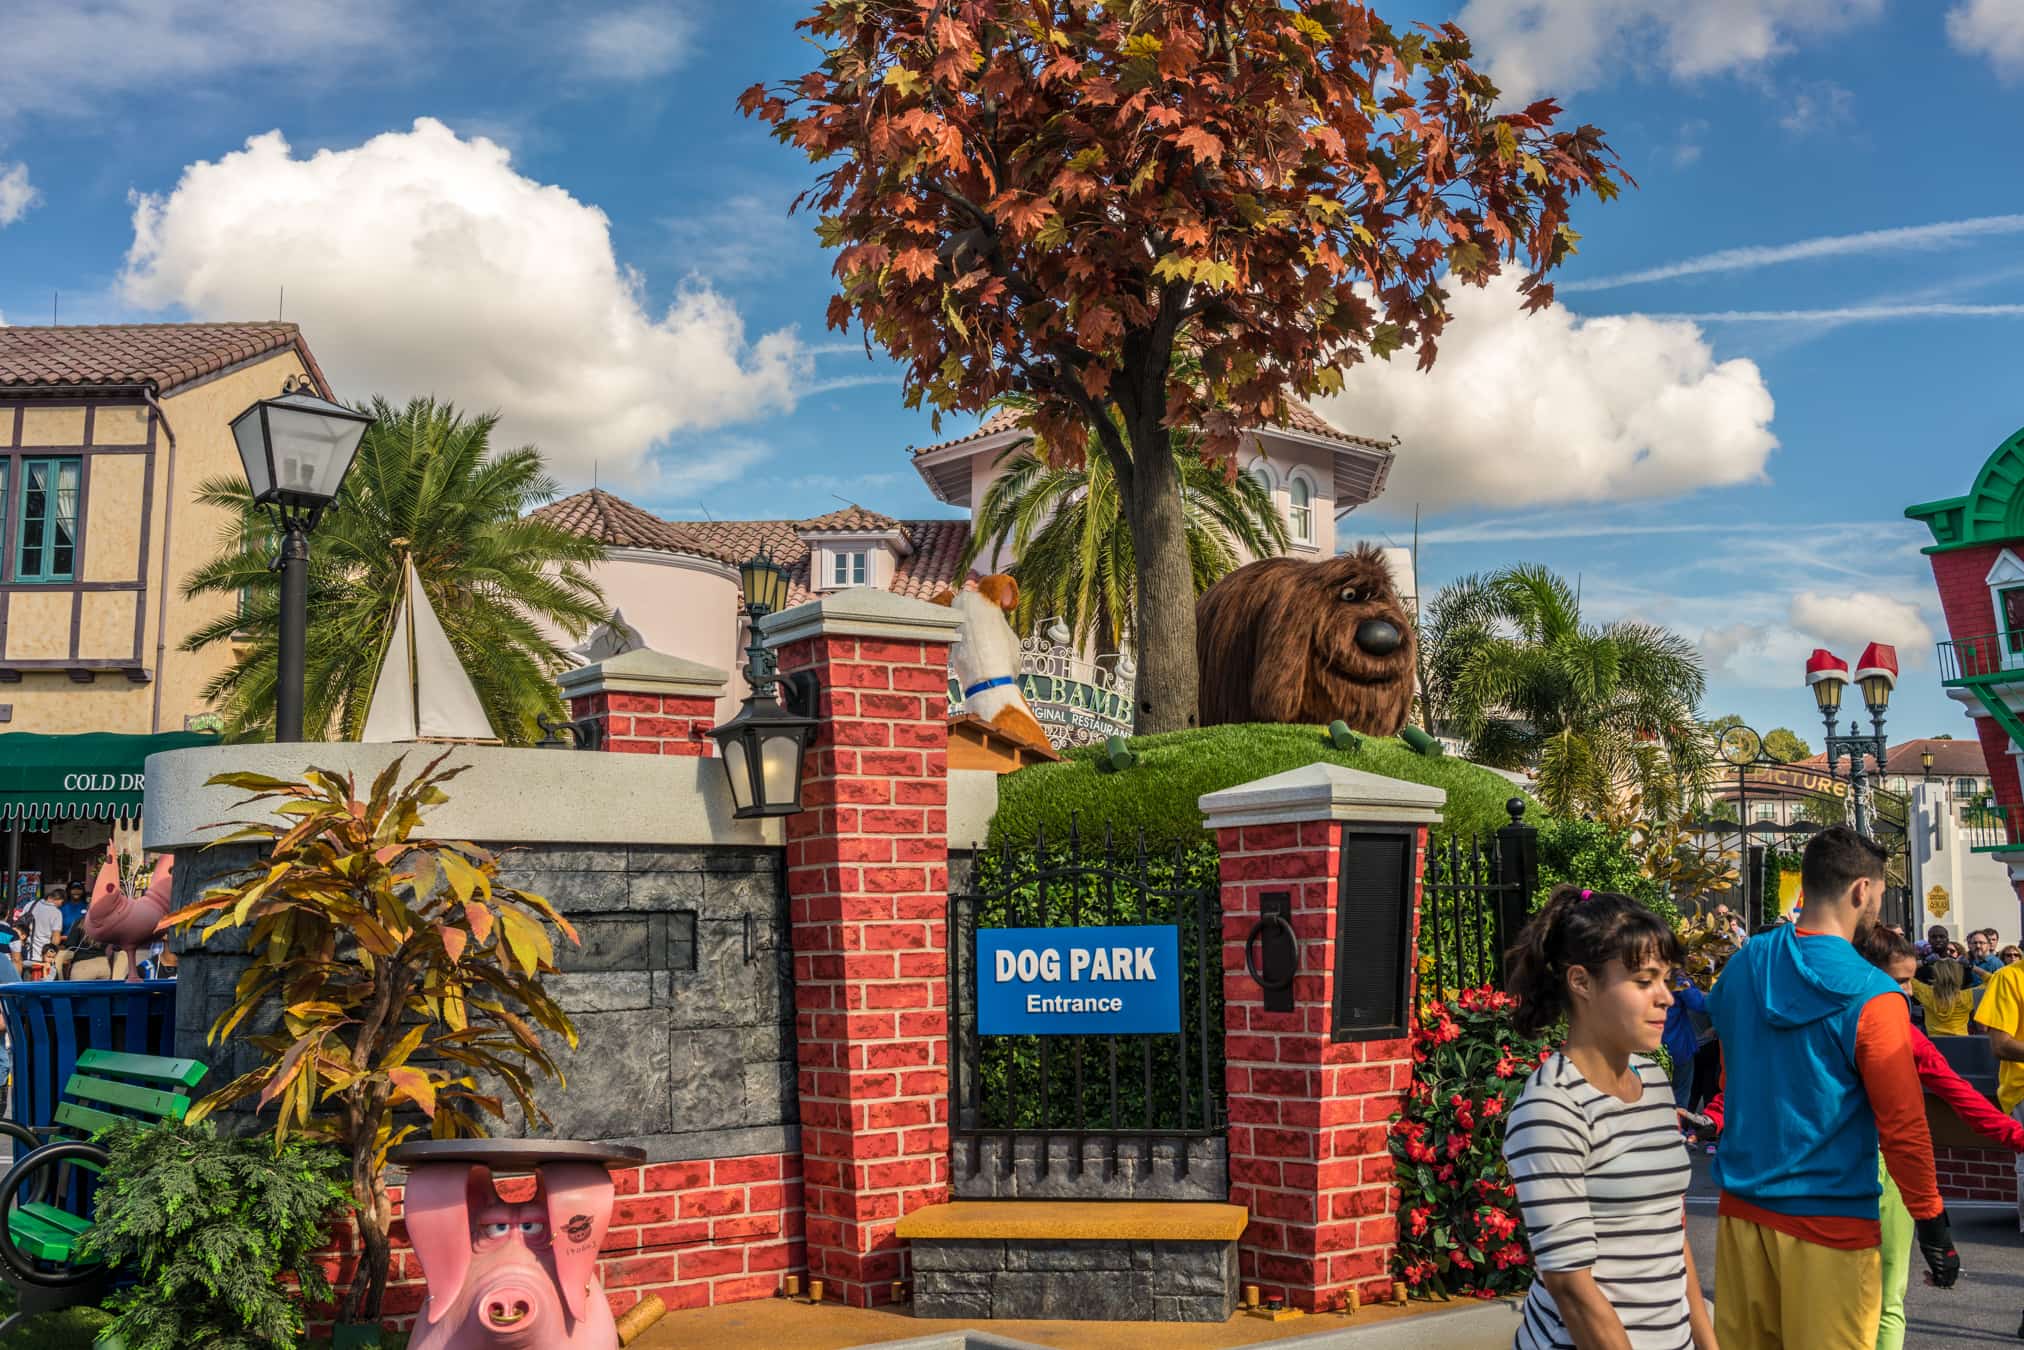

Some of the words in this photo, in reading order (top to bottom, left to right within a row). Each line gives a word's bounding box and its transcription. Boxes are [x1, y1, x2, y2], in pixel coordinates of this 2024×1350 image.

[1051, 677, 1133, 724] BAMB
[64, 773, 116, 791] COLD
[120, 773, 145, 791] DR
[1753, 767, 1855, 799] PICTURE
[995, 949, 1061, 982] DOG
[1070, 947, 1156, 981] PARK
[1027, 994, 1122, 1012] Entrance
